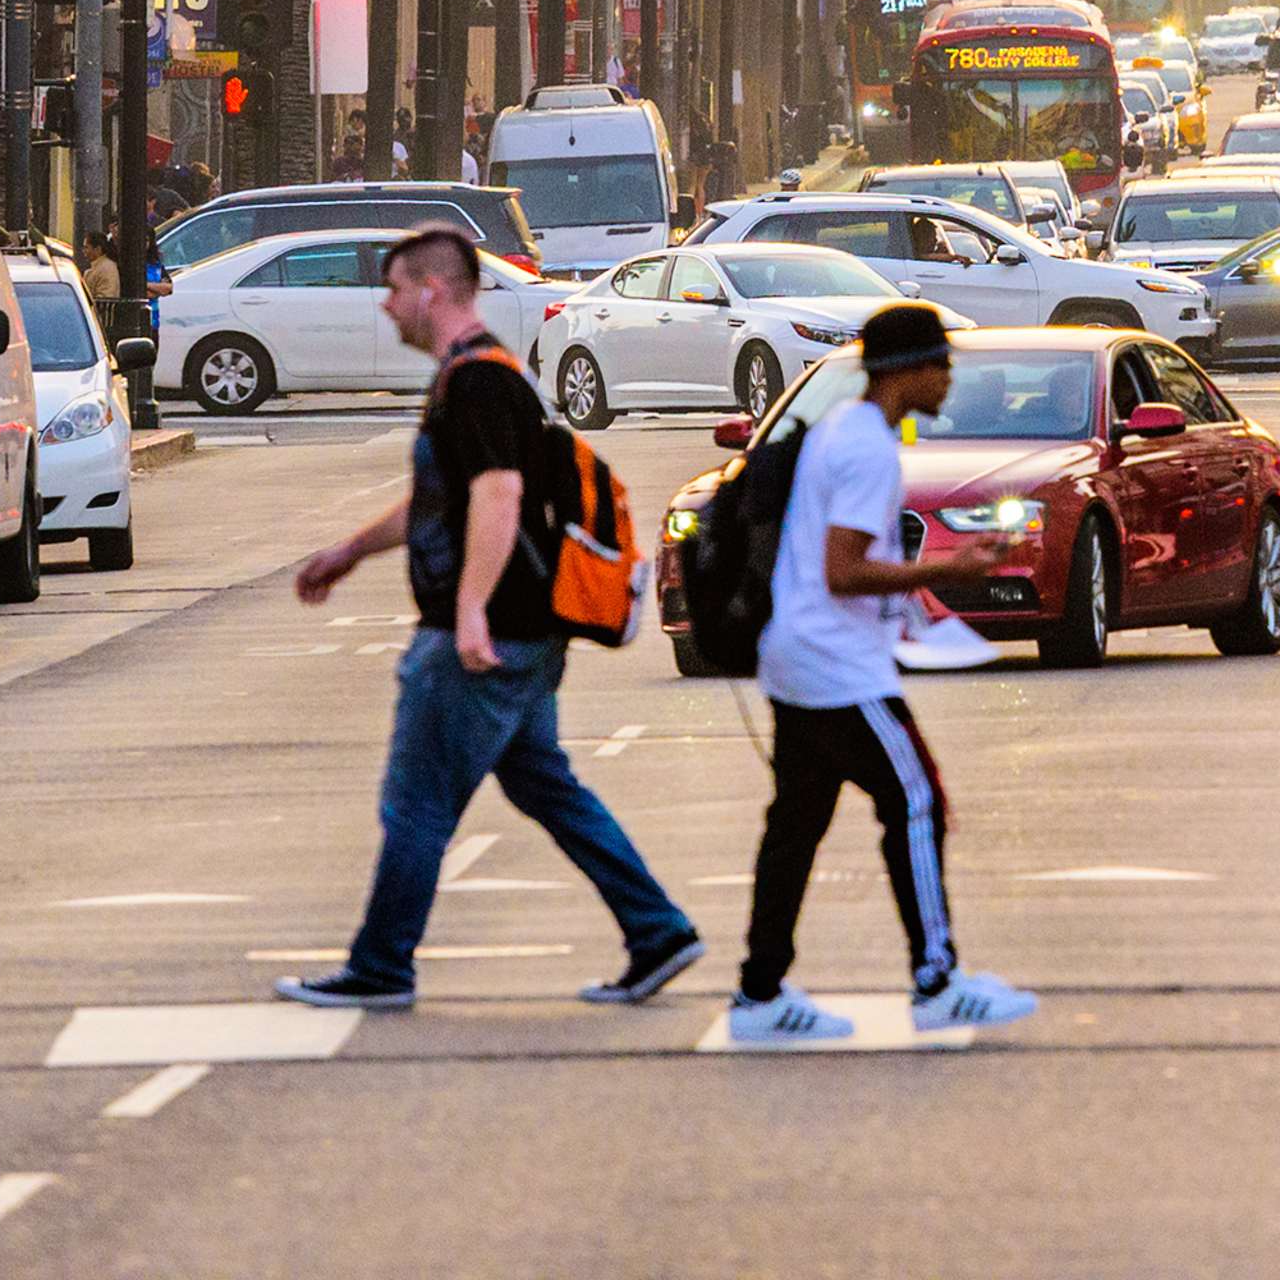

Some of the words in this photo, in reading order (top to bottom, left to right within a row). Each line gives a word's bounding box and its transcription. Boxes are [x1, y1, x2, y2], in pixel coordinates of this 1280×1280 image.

[944, 47, 988, 69] 780
[988, 56, 1020, 69] CITY
[1023, 55, 1080, 69] COLLEGE
[998, 46, 1069, 58] PASADENA
